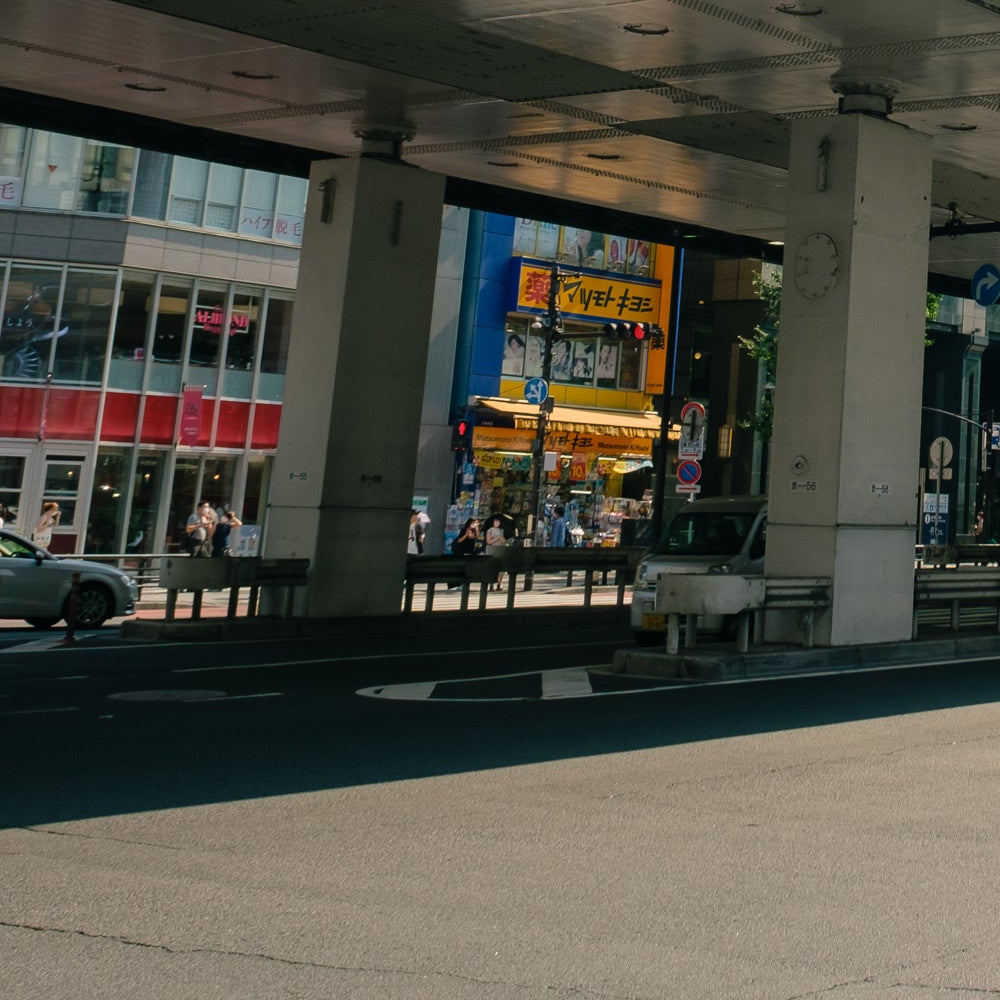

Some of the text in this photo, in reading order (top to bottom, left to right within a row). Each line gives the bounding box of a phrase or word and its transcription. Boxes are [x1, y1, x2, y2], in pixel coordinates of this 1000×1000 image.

[563, 280, 654, 316] マツモトキヨシ
